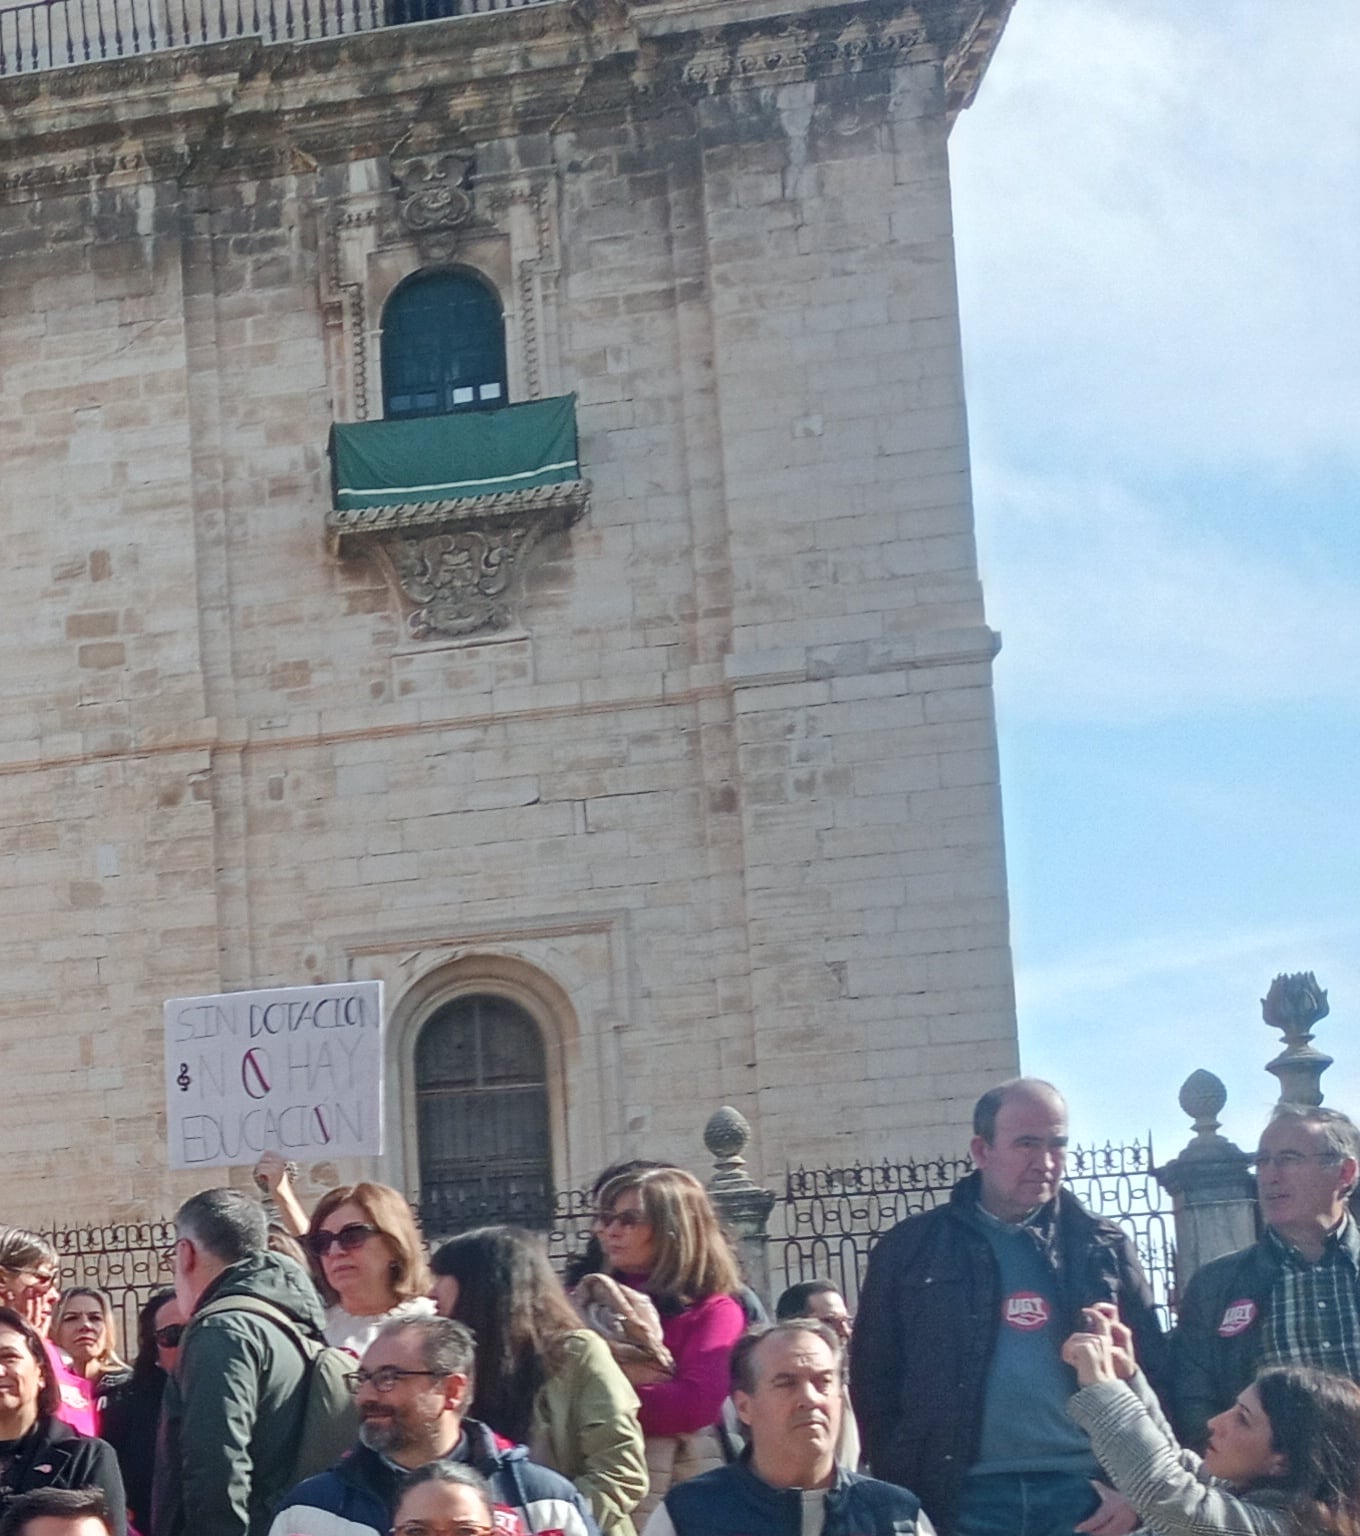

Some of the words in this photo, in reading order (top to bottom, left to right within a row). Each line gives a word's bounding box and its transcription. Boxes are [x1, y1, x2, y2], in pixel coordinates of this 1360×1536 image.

[176, 1004, 238, 1043] SIN
[286, 1034, 364, 1093] HAY
[1008, 1297, 1043, 1316] UGT
